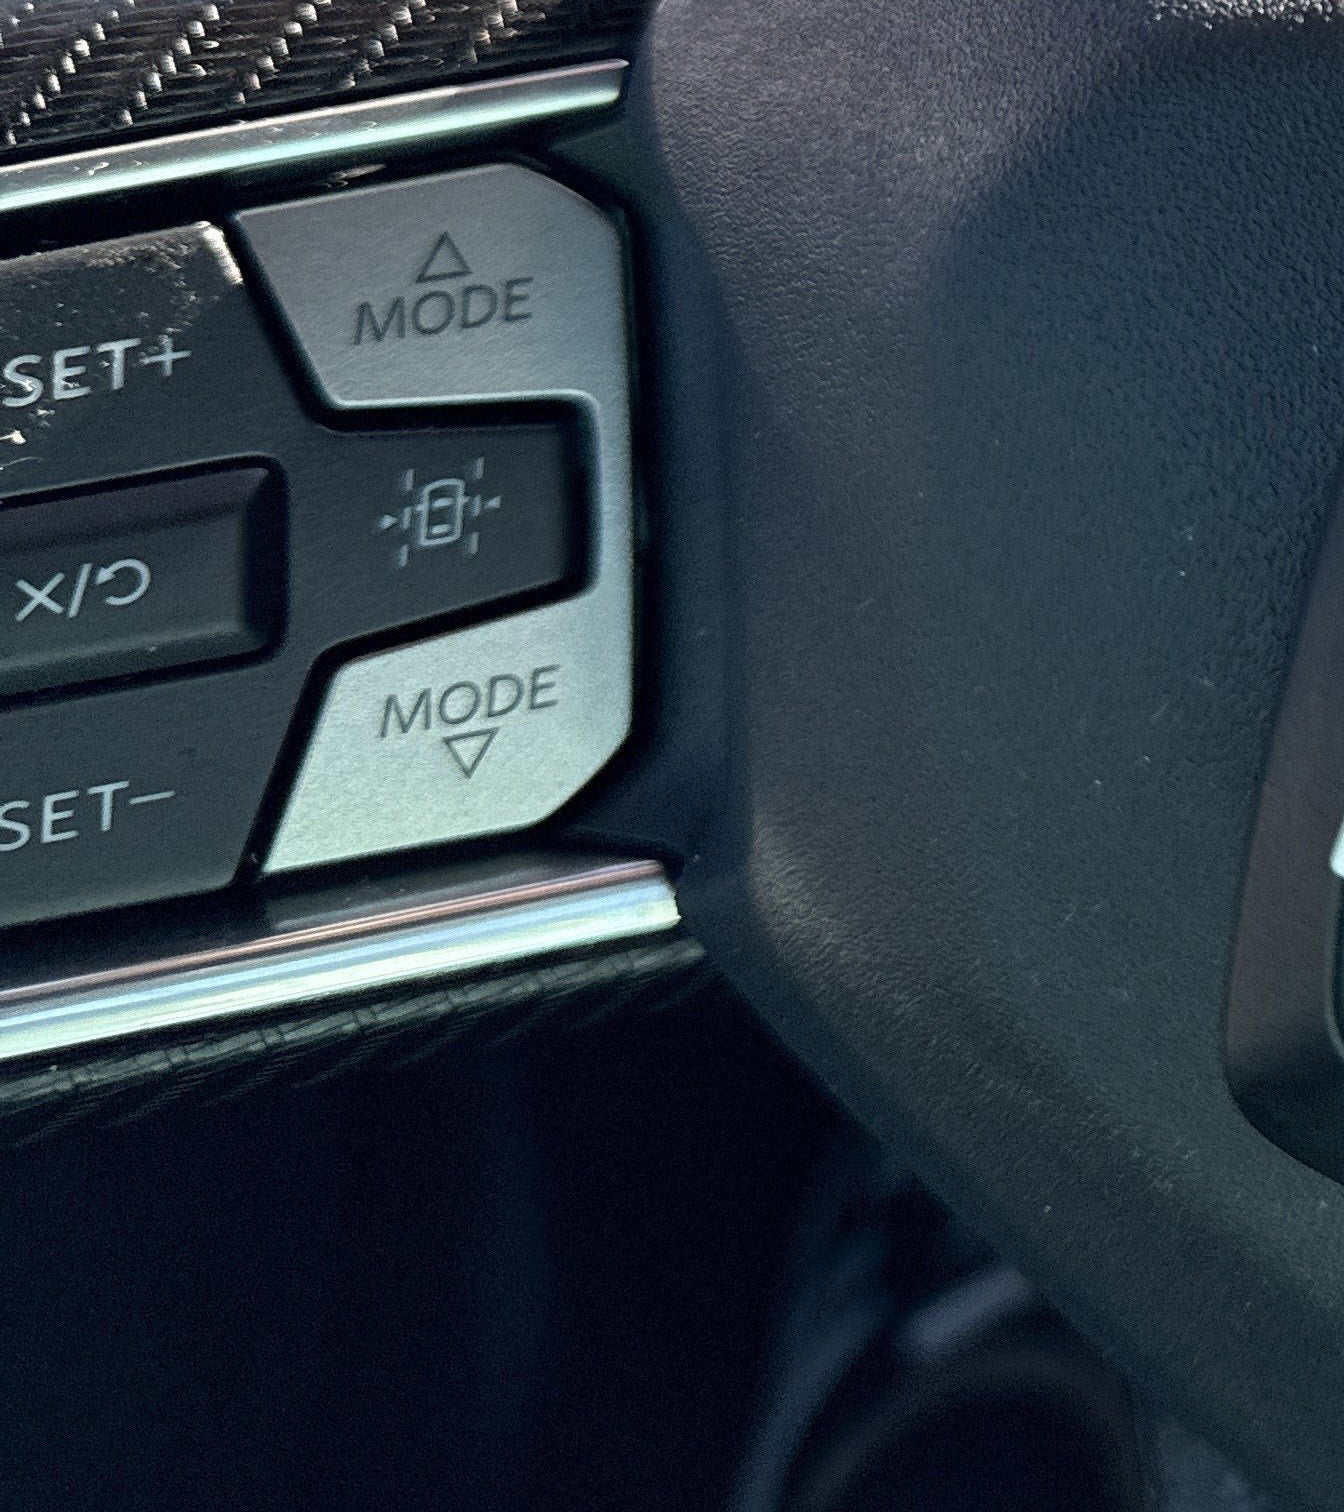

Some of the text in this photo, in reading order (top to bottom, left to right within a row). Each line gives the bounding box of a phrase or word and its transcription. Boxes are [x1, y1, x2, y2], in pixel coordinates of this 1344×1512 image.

[351, 275, 538, 348] MODE
[2, 335, 193, 409] SET+
[378, 664, 562, 739] MODE
